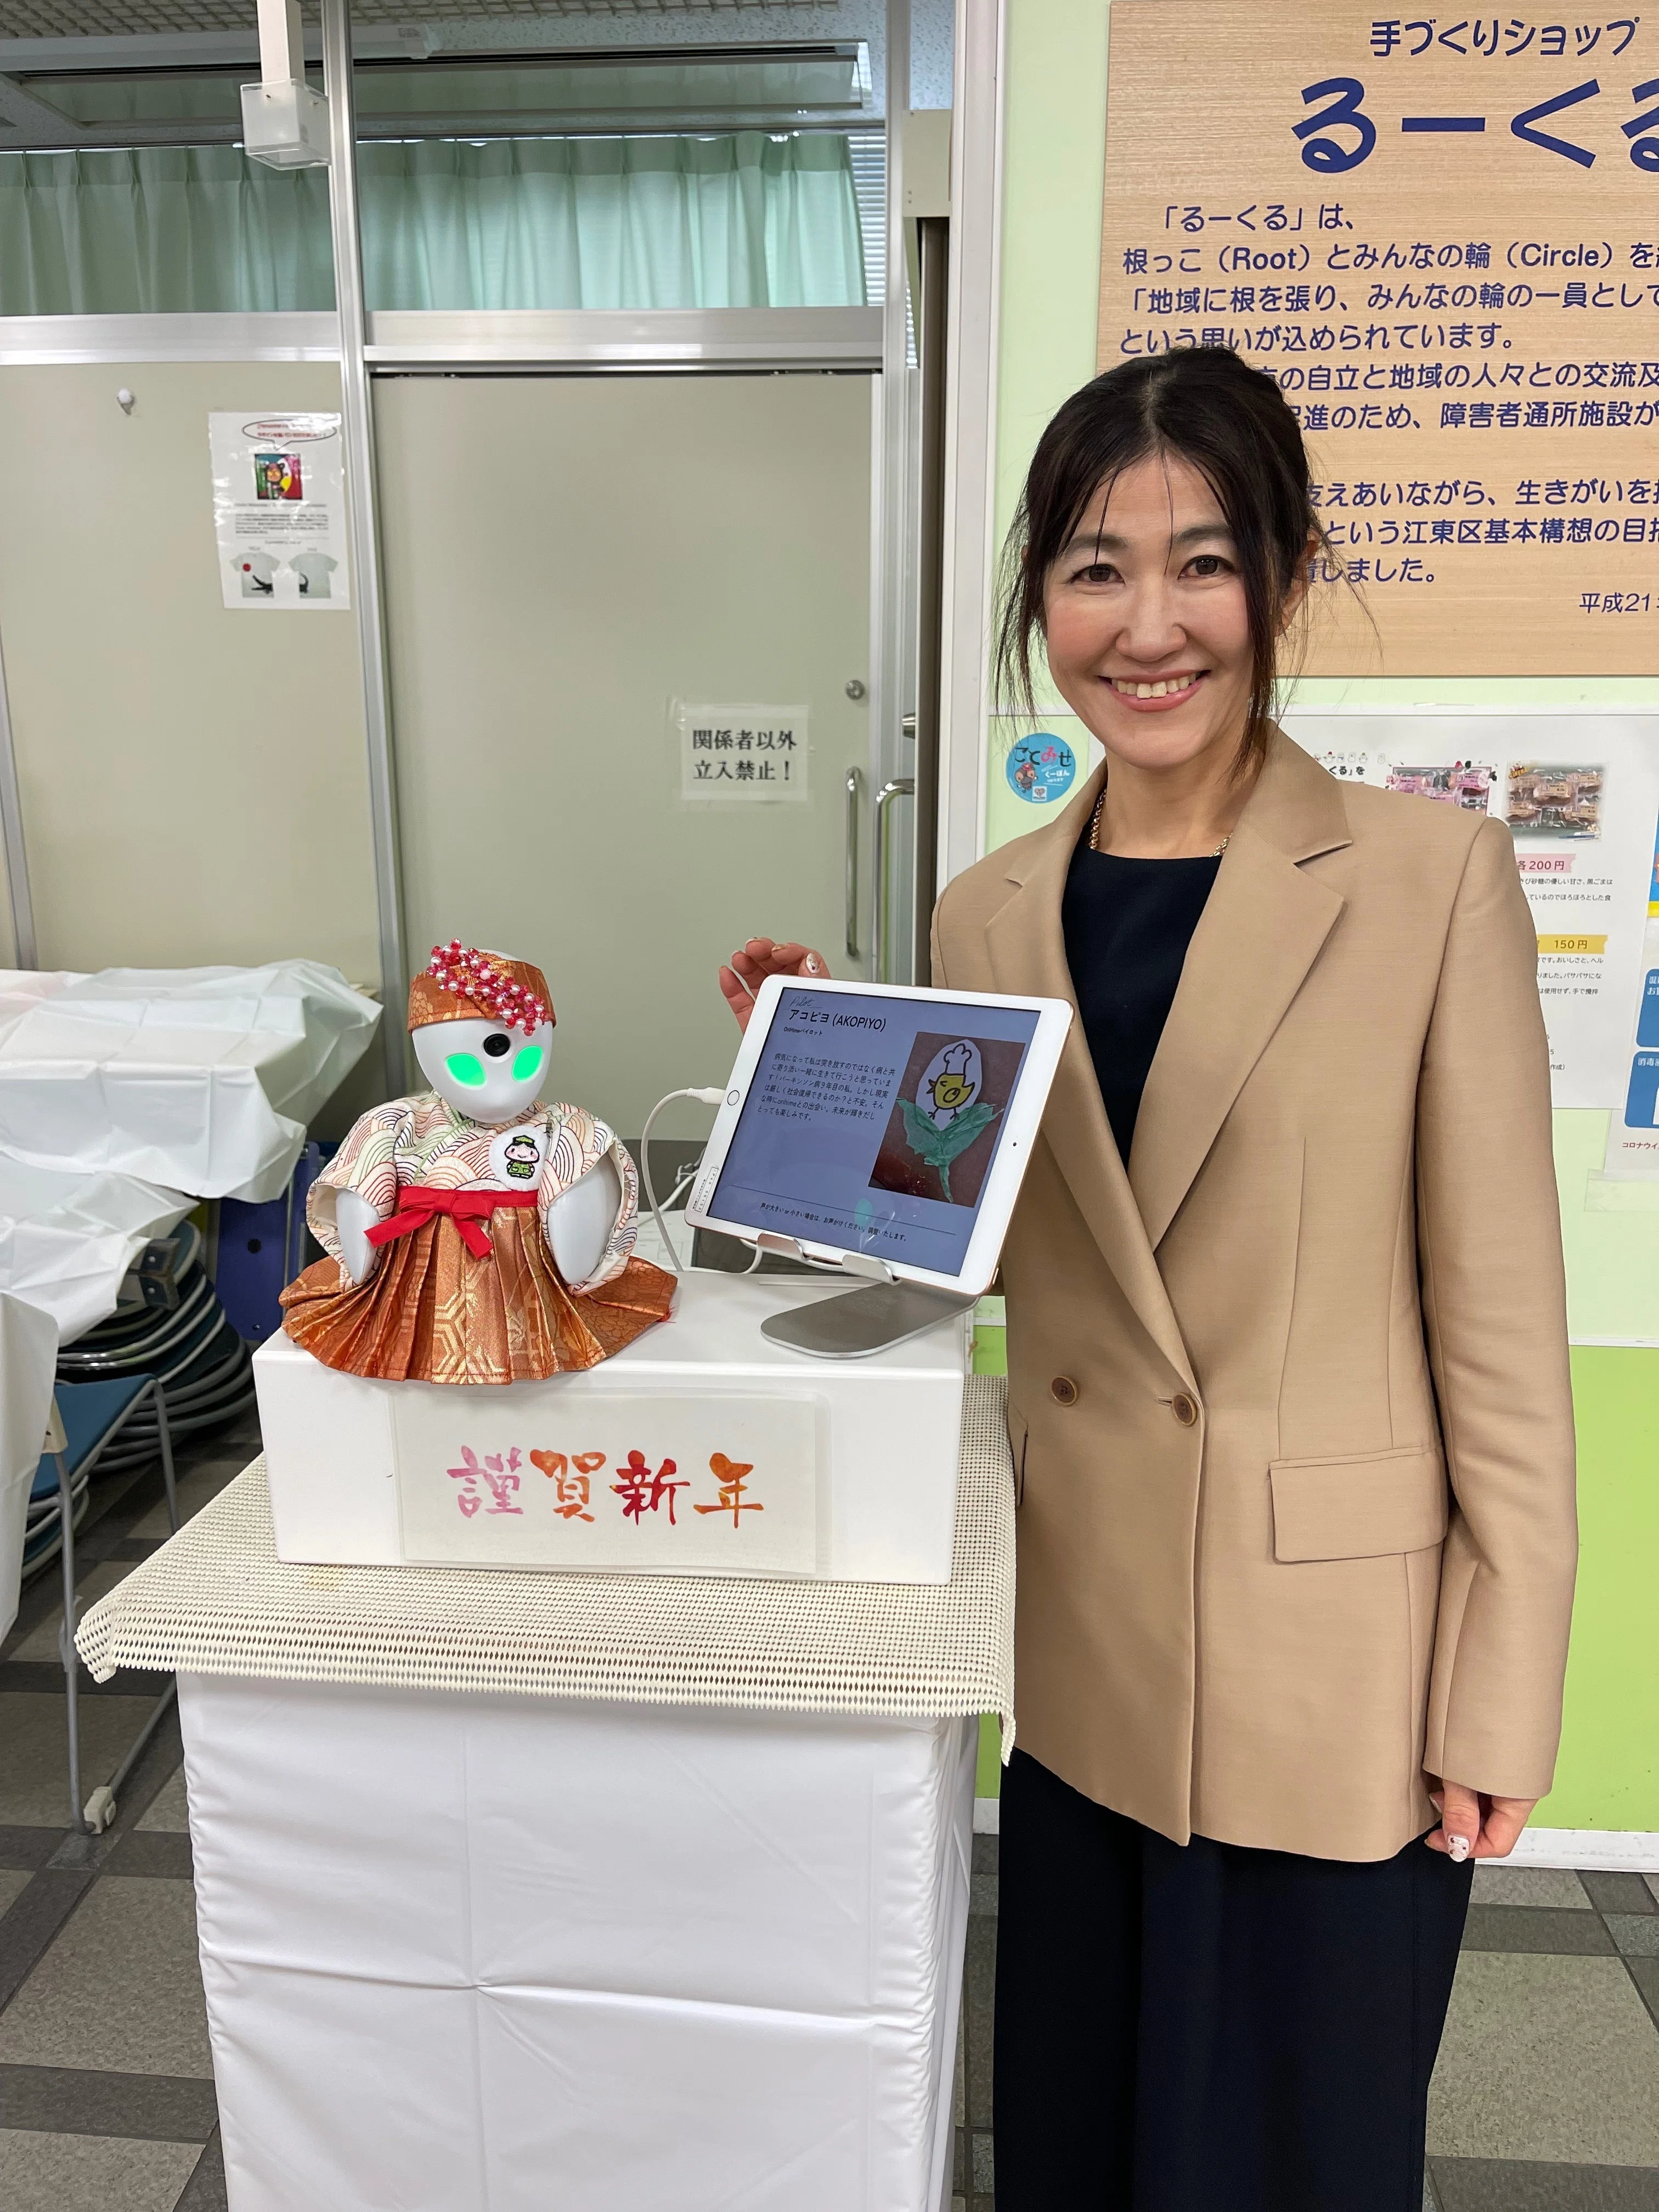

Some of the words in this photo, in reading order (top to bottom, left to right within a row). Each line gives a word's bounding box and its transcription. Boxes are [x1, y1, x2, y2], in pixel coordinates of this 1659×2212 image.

[1369, 16, 1641, 57] 手づくりショップ
[1164, 203, 1355, 233] 「るーくる」は、
[1122, 241, 1659, 274] 根っこ（Root）とみんなの輪（Circle）を
[1120, 323, 1513, 356] という思いが込められています。
[1579, 592, 1659, 613] 平成21
[692, 729, 797, 751] 関係者以外
[692, 759, 790, 781] 立入禁止！
[789, 996, 815, 1008] Pilot
[789, 1009, 830, 1023] アコピヨ
[832, 1013, 887, 1032] (AKOPIYO)
[757, 1105, 812, 1122] とっても楽しみです。
[1622, 1142, 1659, 1150] コロナウイ
[446, 1444, 764, 1530] 謹賀新年
